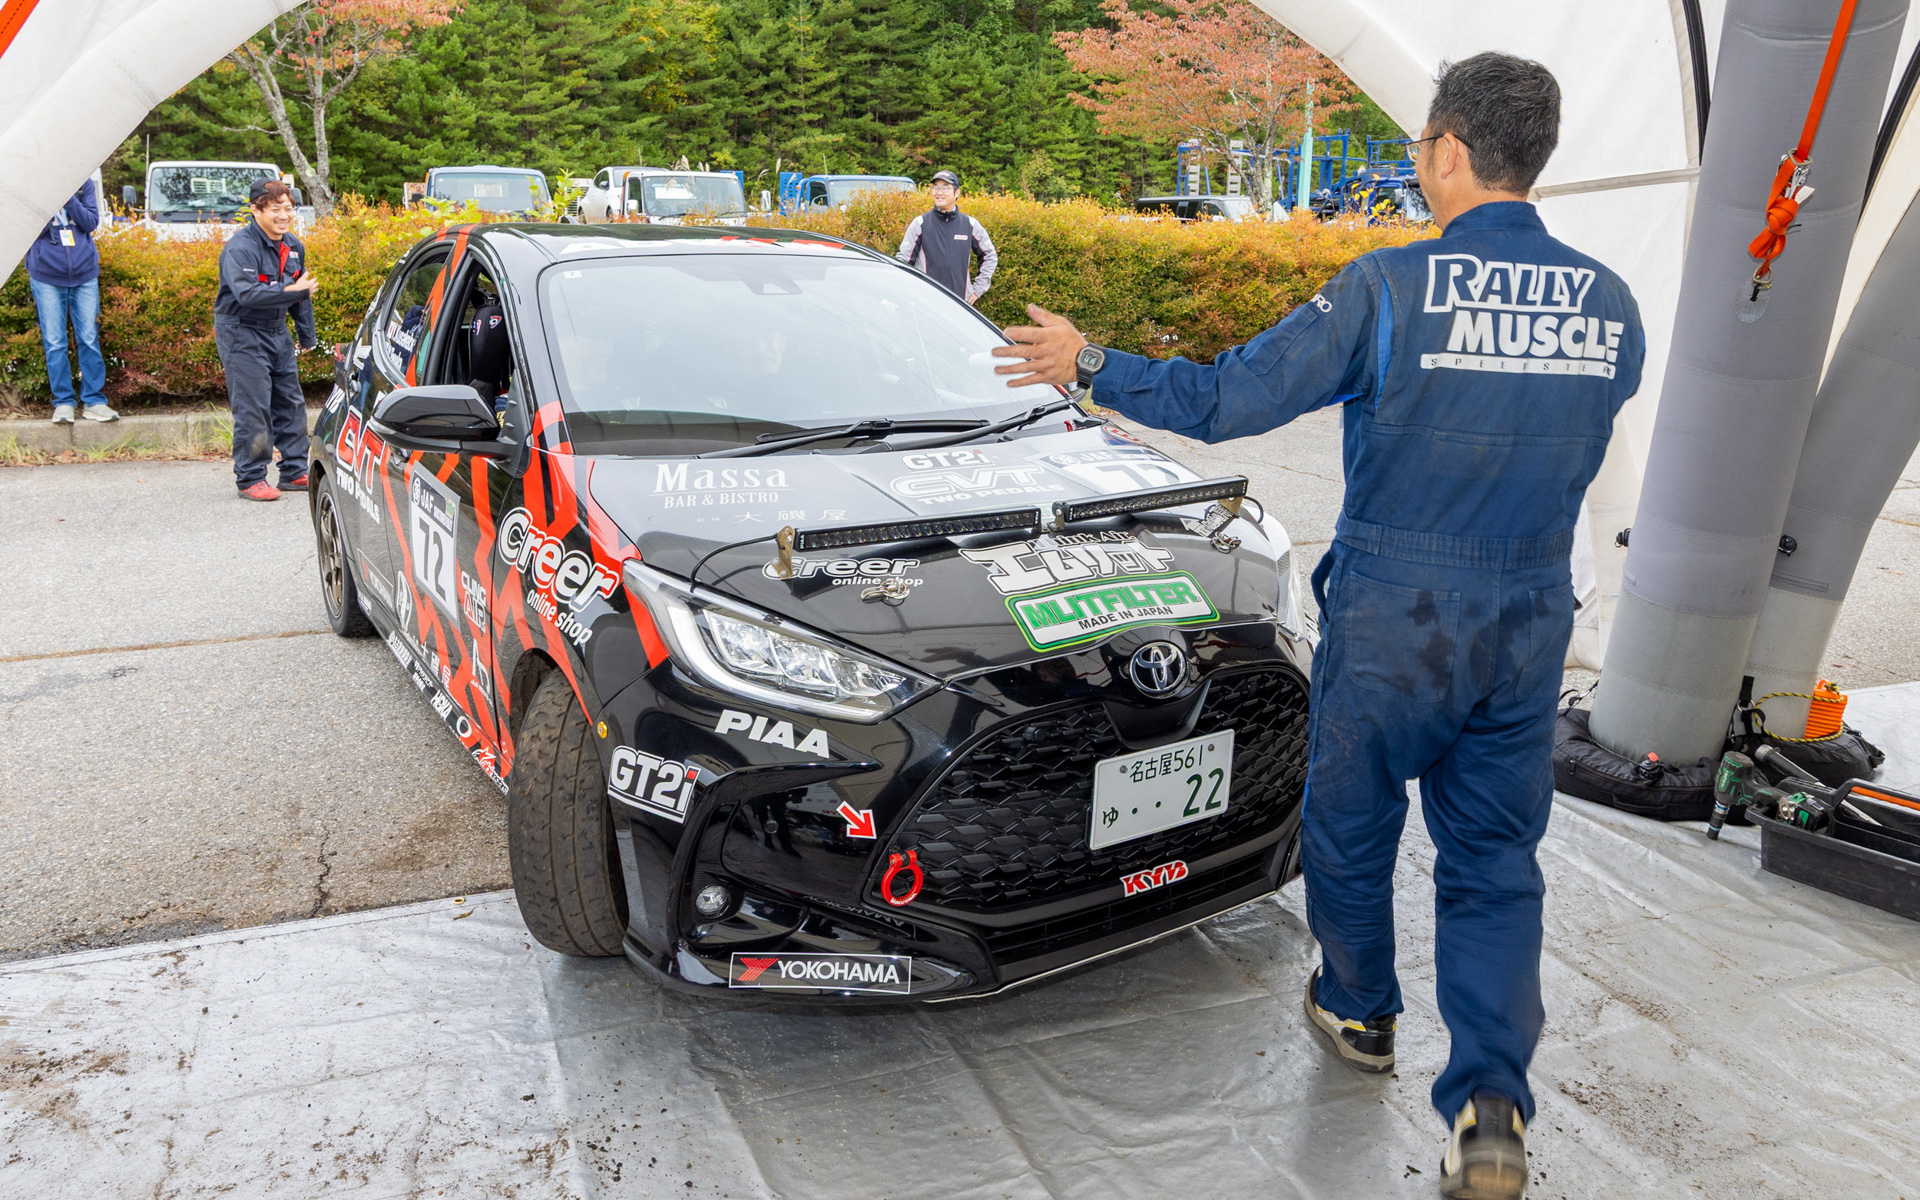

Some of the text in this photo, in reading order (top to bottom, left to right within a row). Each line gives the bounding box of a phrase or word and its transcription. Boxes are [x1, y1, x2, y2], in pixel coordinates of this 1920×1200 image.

[1423, 254, 1596, 313] RALLY
[1447, 310, 1624, 363] MUSCLE
[902, 449, 993, 470] GT2i
[336, 466, 355, 495] TWO
[653, 463, 789, 492] Massa
[420, 489, 434, 513] JAF
[664, 491, 779, 509] BAR & BISTRO
[917, 484, 1065, 505] TWO PEDALS
[419, 517, 446, 602] 72
[499, 507, 620, 613] Creer
[762, 556, 920, 580] Creer
[959, 540, 1174, 594] エムリット
[832, 577, 881, 586] online
[526, 589, 593, 647] online shop
[1019, 582, 1200, 630] MLITFILTER
[1078, 606, 1174, 630] MADE IN JAPAN
[715, 709, 830, 759] PIAA
[610, 745, 701, 813] GT2i
[1102, 807, 1119, 828] ゆ
[1120, 860, 1189, 897] KYB
[778, 960, 900, 984] YOKOHAMA
